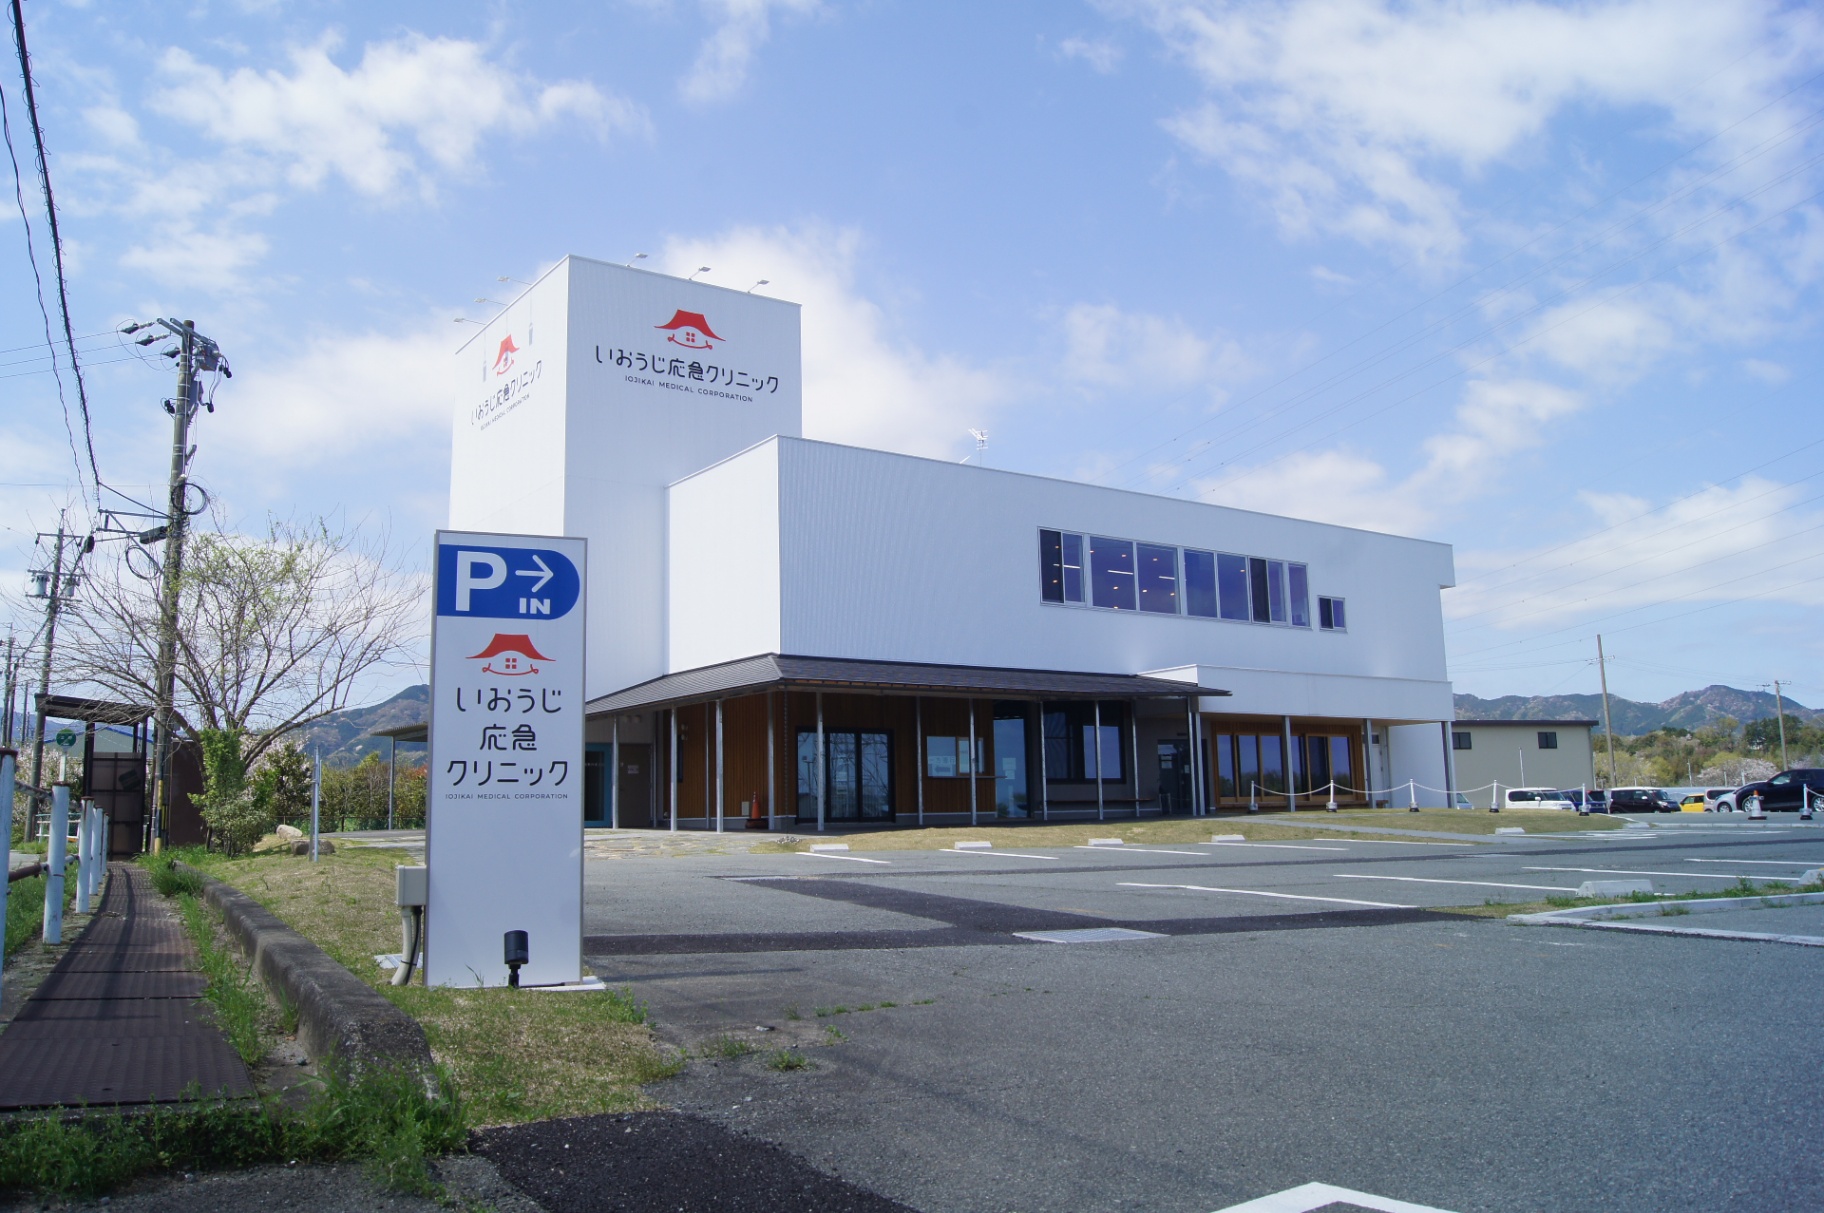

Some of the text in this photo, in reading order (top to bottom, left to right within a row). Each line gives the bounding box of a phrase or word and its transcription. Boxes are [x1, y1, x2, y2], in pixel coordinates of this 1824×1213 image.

[595, 345, 779, 393] いおうじ応急クリニック
[625, 374, 753, 402] IOJIKAI MEDICAL CORPORATION
[455, 550, 508, 612] P
[519, 597, 551, 615] IN
[456, 687, 562, 714] いおうじ
[479, 723, 538, 751] 応急
[446, 760, 569, 787] クリニック
